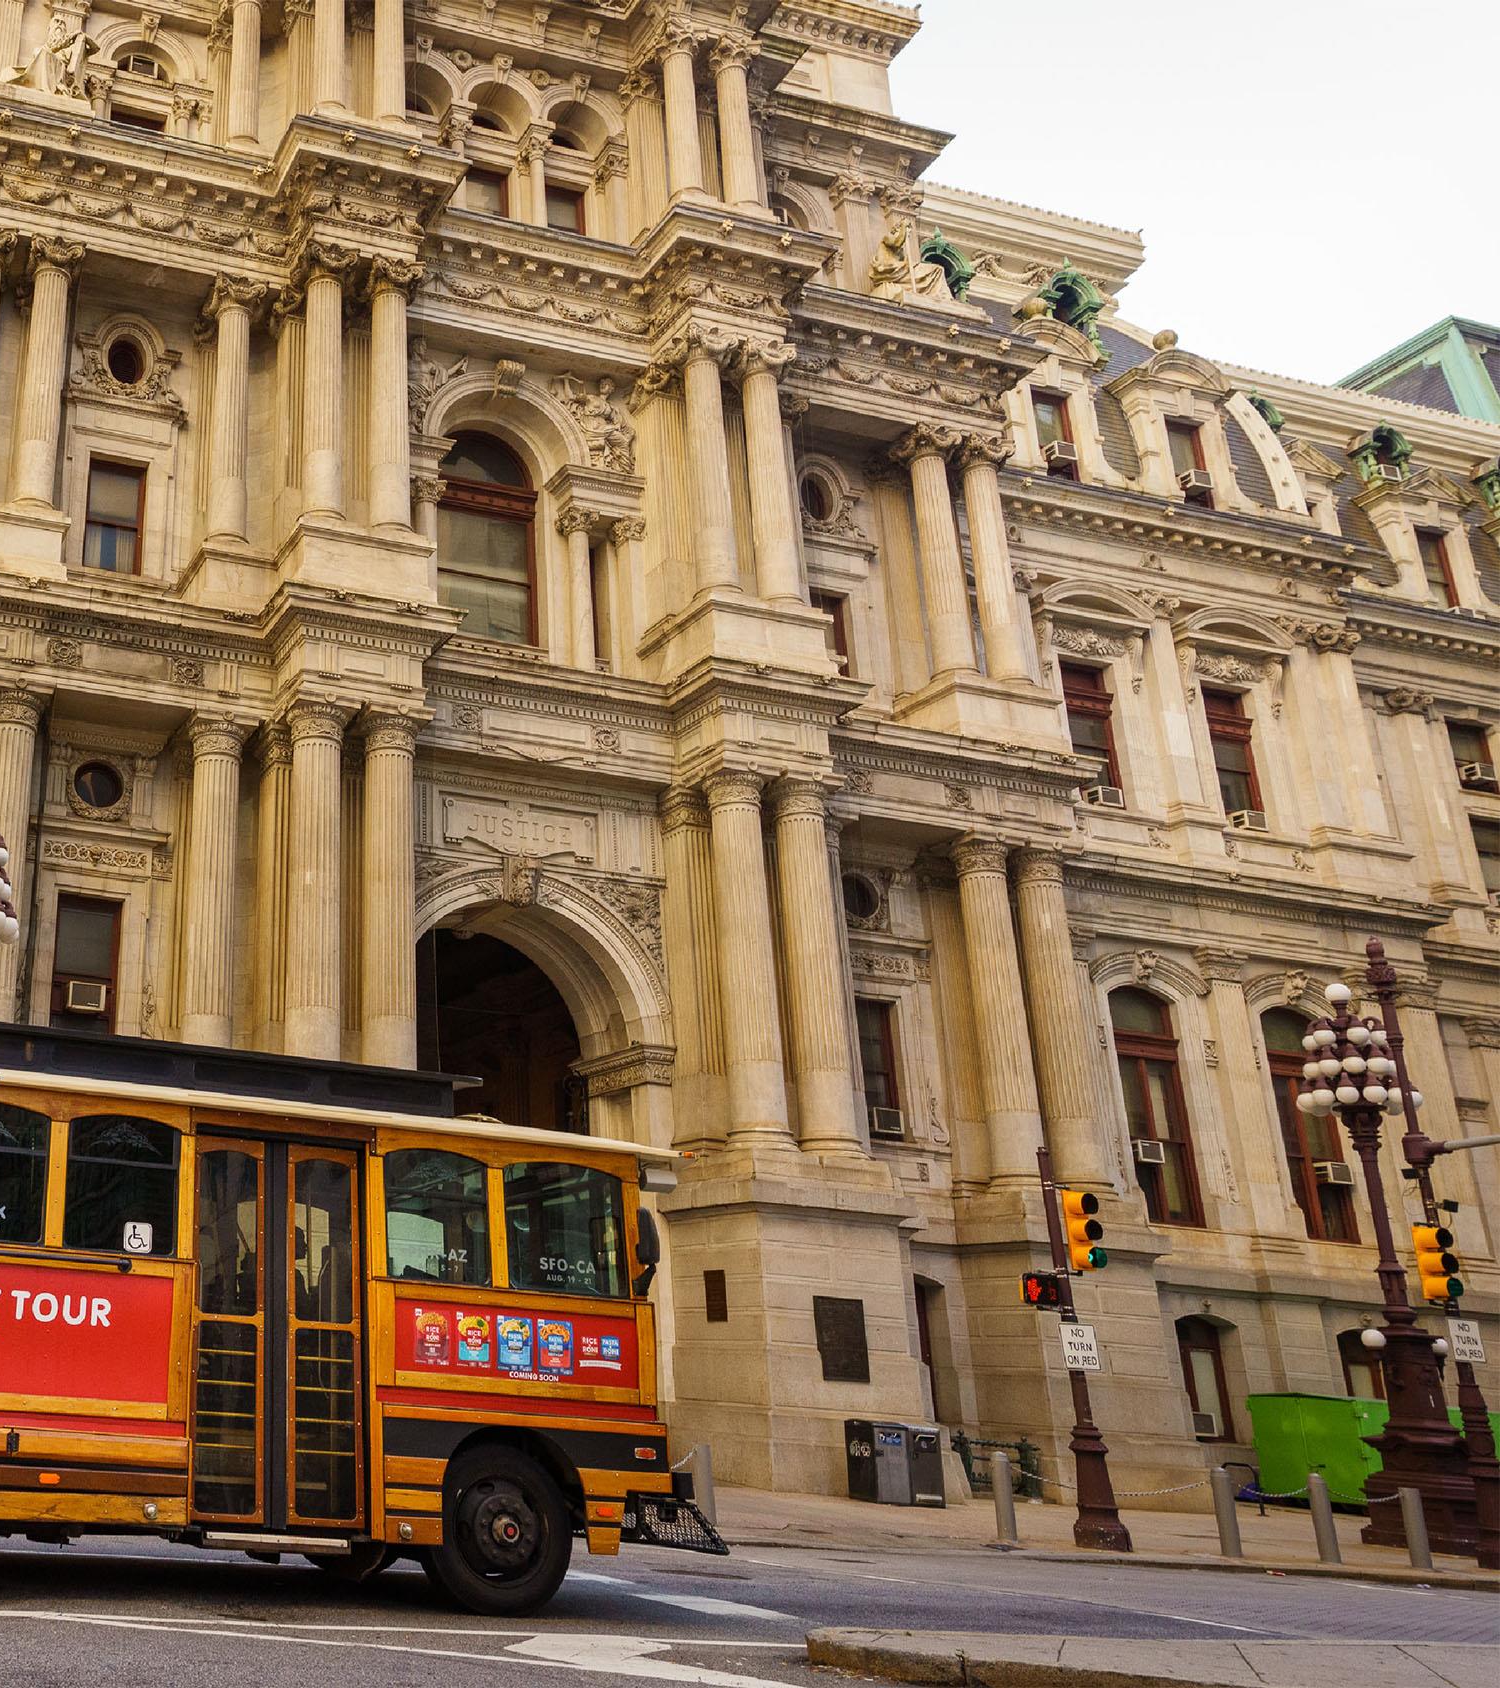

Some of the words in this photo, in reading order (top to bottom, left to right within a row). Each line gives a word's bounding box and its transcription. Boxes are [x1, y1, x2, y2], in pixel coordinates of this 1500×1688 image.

[467, 814, 572, 846] JUSTICE
[539, 1256, 596, 1275] SFO-CA
[546, 1274, 566, 1283] AUG.
[11, 1289, 112, 1328] TOUR
[1457, 1322, 1471, 1332] NO
[1070, 1328, 1085, 1338] NO
[1455, 1335, 1479, 1346] TURN
[1067, 1341, 1093, 1352] TURN
[1455, 1347, 1468, 1357] ON
[1468, 1349, 1483, 1359] RED
[1067, 1355, 1080, 1365] ON
[1081, 1356, 1098, 1366] RED
[509, 1371, 538, 1380] COMING
[539, 1374, 559, 1382] SOON
